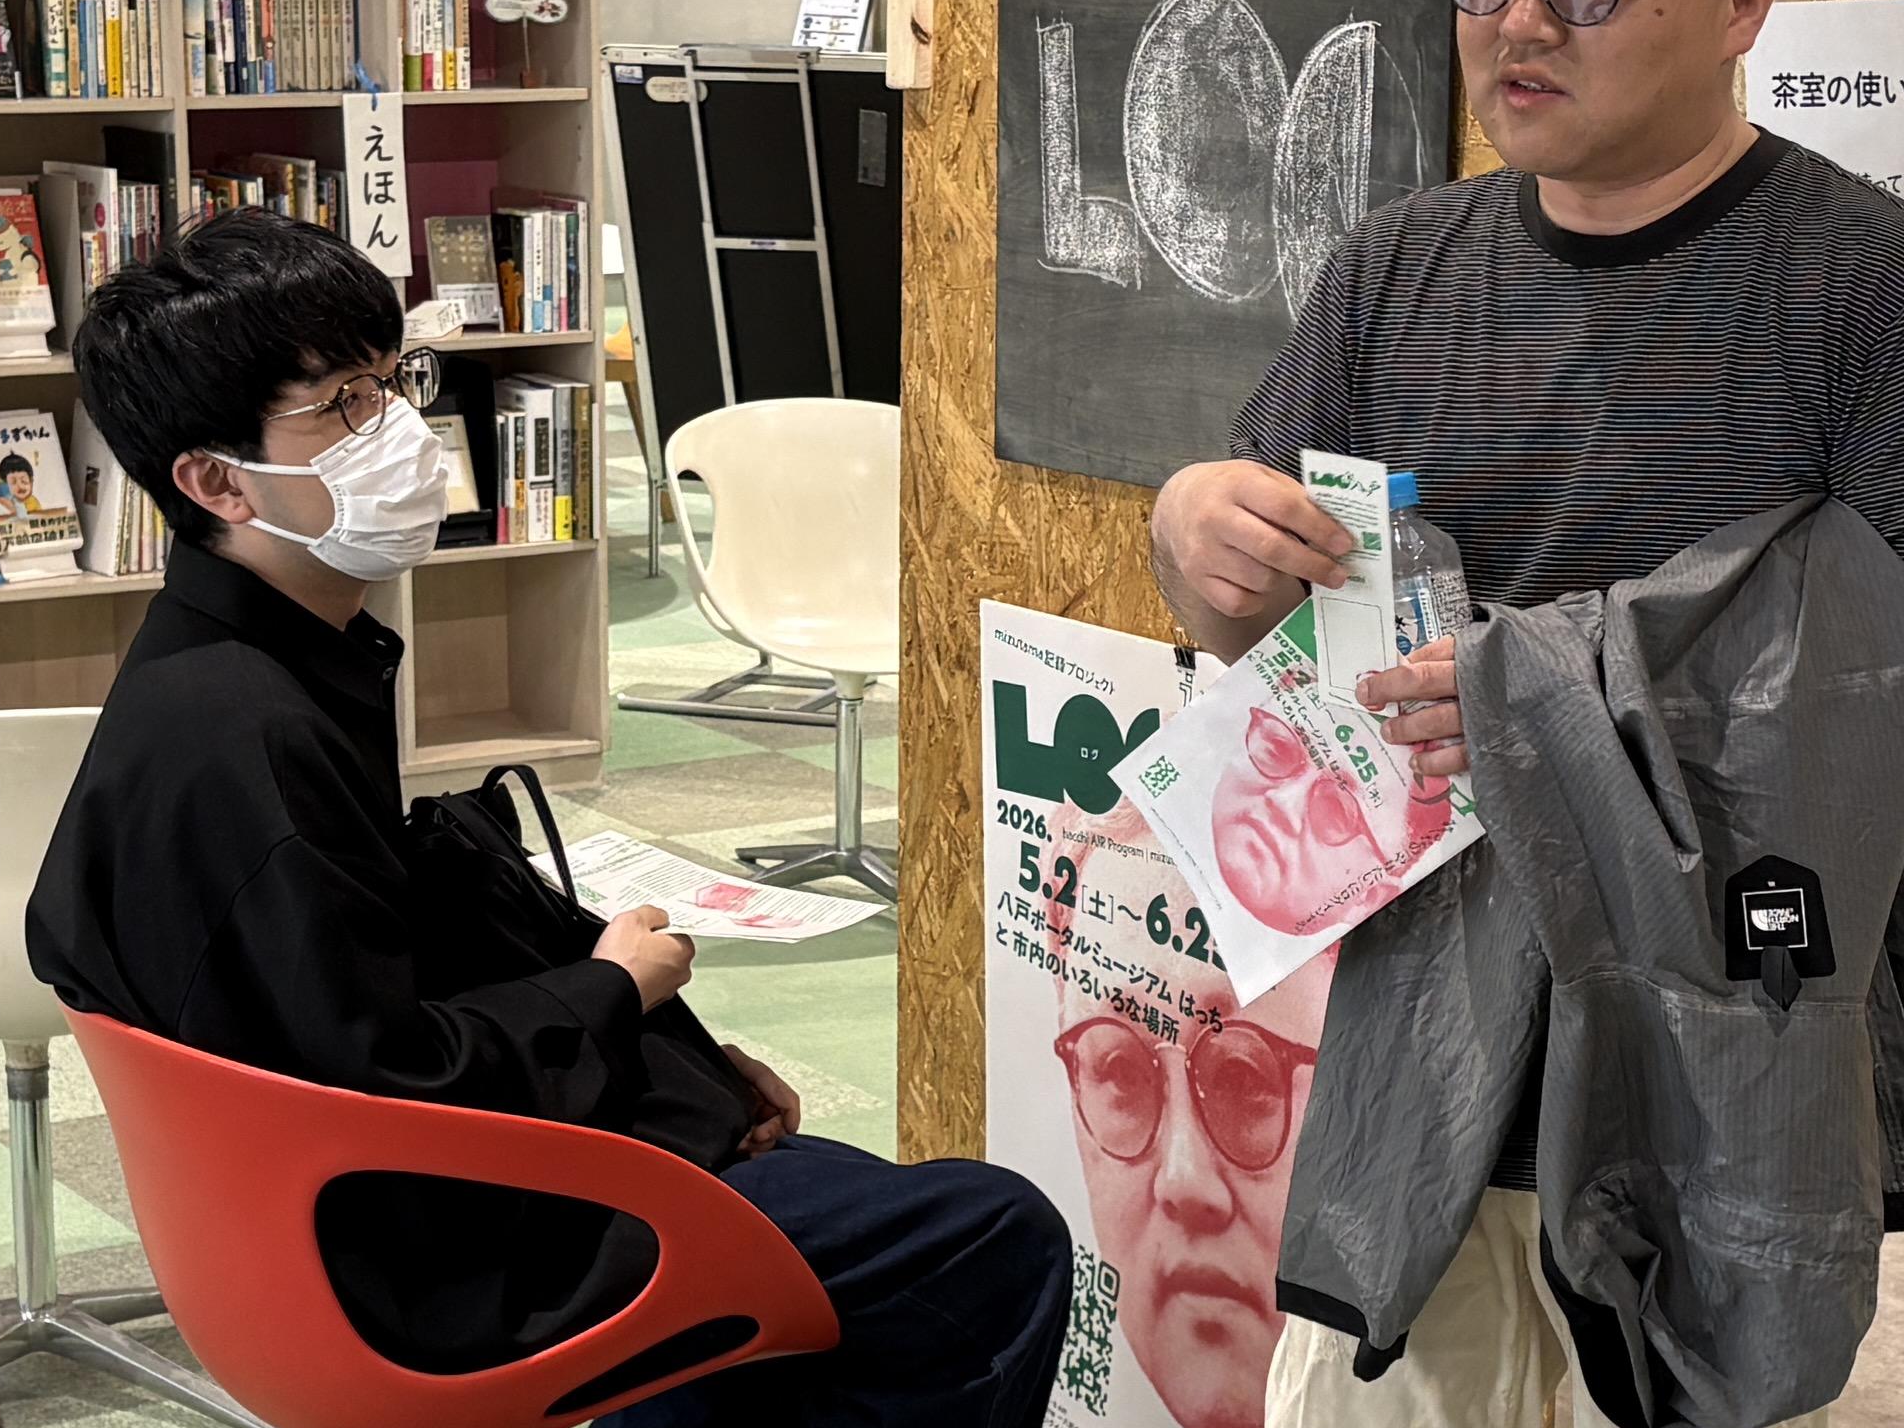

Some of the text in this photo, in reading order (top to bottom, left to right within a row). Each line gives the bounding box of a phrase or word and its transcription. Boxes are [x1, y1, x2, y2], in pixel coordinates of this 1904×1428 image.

[363, 124, 399, 249] えほん
[996, 798, 1053, 844] 2026.
[996, 890, 1225, 1035] 八戸ポータルミュージアム はっち
[1012, 934, 1181, 1044] 市内のいろいろな場所
